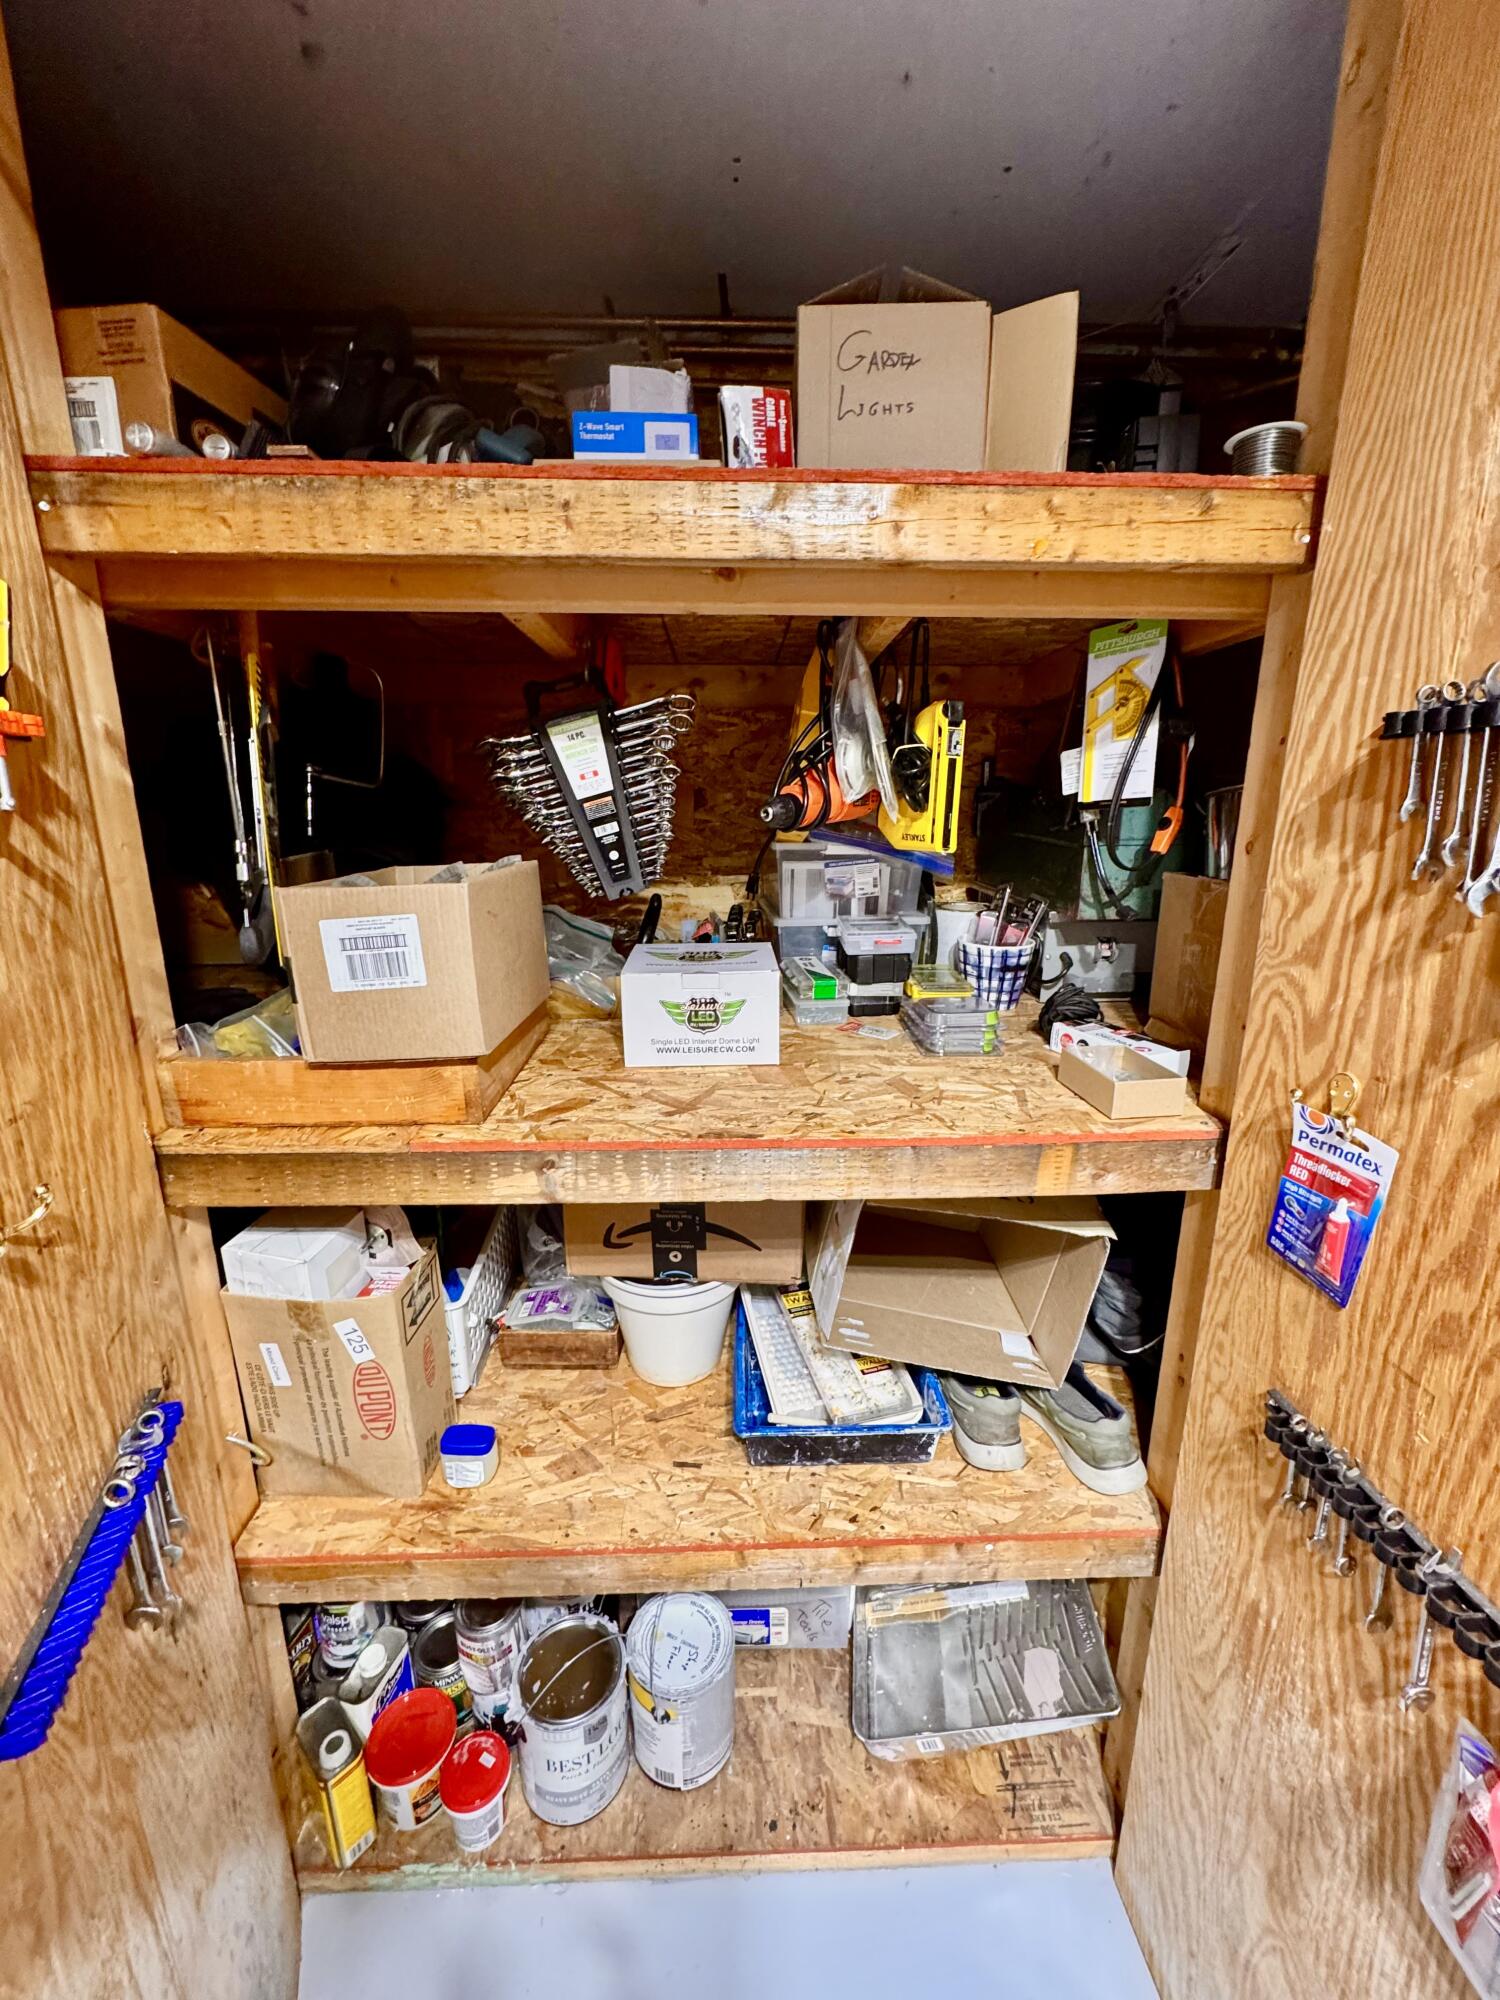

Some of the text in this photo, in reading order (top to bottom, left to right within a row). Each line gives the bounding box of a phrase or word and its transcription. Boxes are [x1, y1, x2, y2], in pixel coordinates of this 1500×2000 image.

[751, 398, 767, 447] WINCH
[765, 397, 776, 428] CABLE
[579, 422, 625, 431] Z-Wave Smart
[579, 432, 615, 441] Thermostat
[1093, 628, 1161, 652] PITTSBURGH
[901, 833, 926, 842] STANLEY
[690, 1011, 716, 1022] LED
[650, 1038, 673, 1046] Single
[719, 1037, 741, 1045] Dome
[742, 1037, 760, 1046] Light
[656, 1045, 756, 1054] WWW.LEISURECW.COM
[1298, 1129, 1384, 1177] Permatex
[1289, 1165, 1308, 1182] RED
[1293, 1152, 1352, 1188] Threadlocker
[343, 1328, 369, 1354] 125
[812, 1599, 833, 1632] Tile
[546, 1748, 595, 1773] BEST
